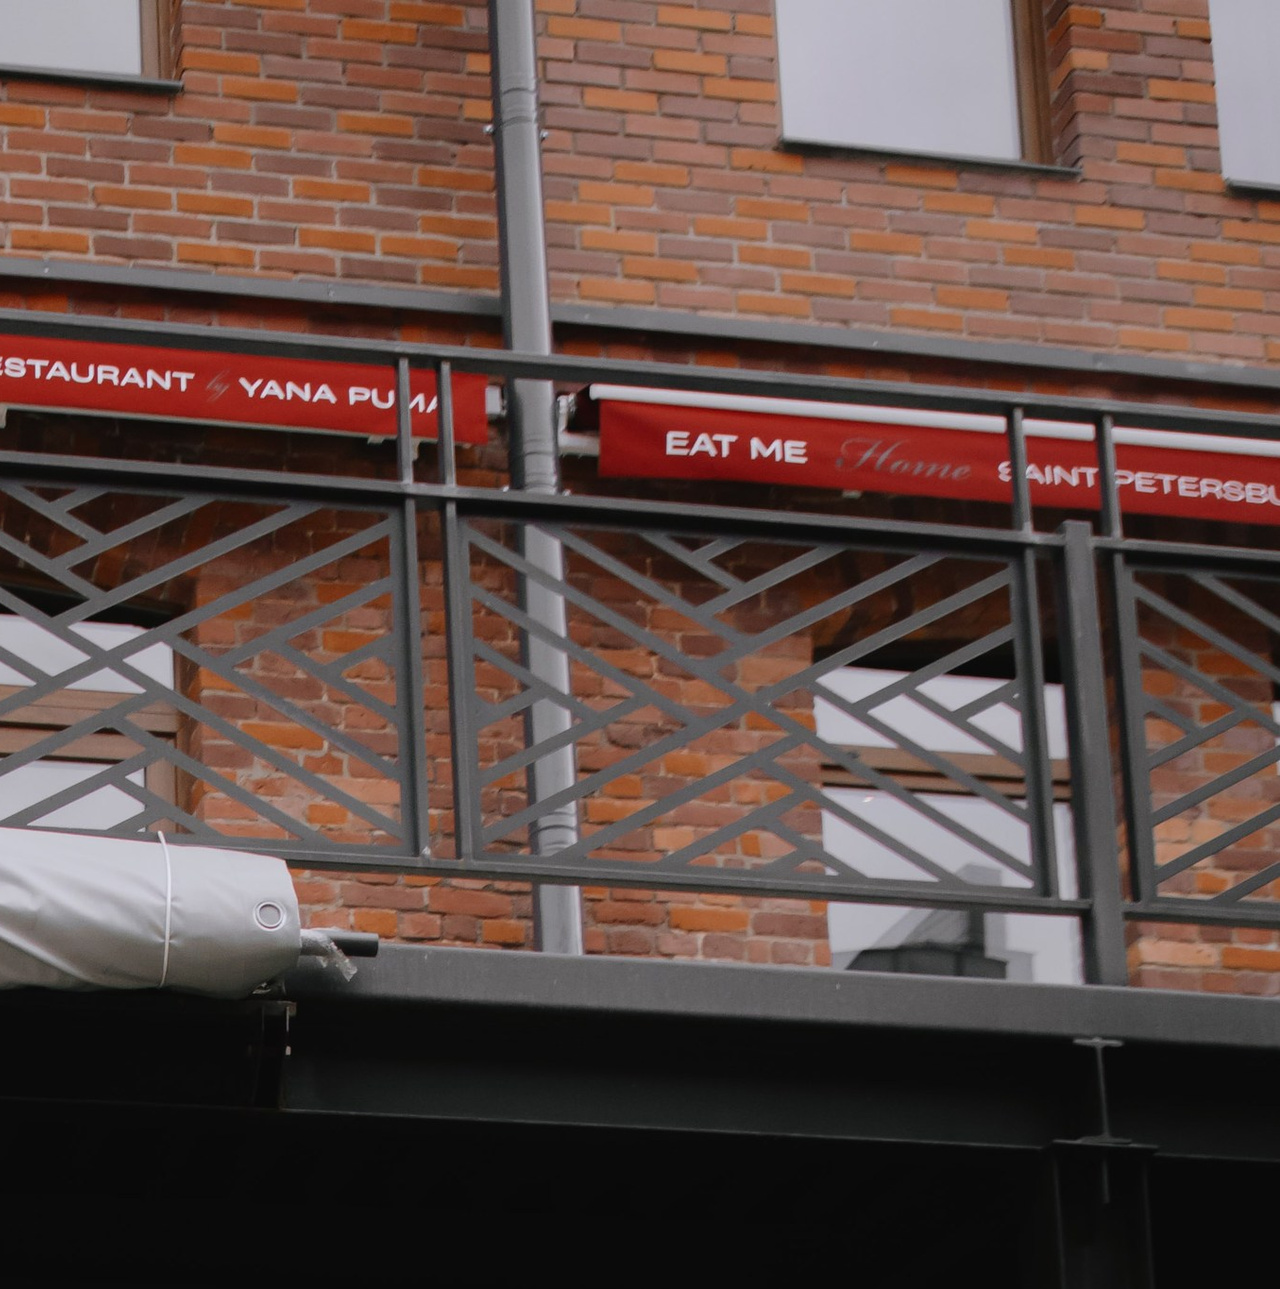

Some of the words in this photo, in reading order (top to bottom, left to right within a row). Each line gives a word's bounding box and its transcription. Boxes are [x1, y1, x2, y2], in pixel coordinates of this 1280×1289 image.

[238, 377, 337, 404] YANA
[666, 430, 737, 457] EAT
[750, 437, 807, 464] ME
[836, 437, 971, 482] Home
